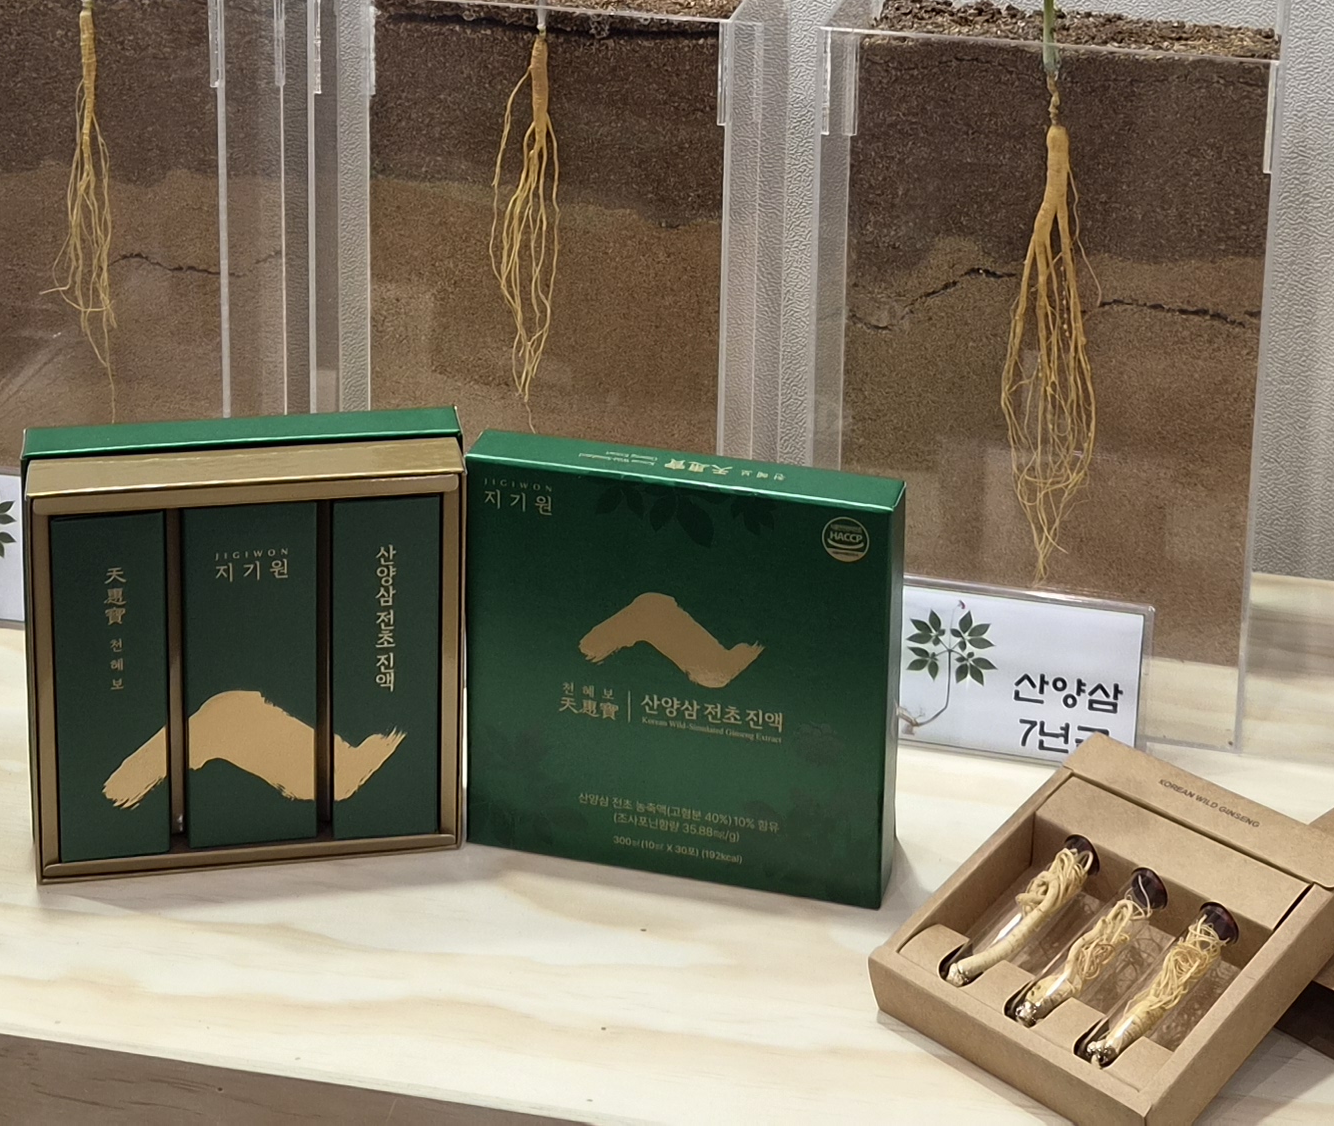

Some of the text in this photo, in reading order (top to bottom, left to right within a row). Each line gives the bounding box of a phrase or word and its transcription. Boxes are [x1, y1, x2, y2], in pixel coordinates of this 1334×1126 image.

[484, 477, 552, 492] JIGIWON
[484, 488, 553, 516] 지기원
[829, 531, 863, 543] HACCP
[215, 548, 289, 561] JIGIWON
[215, 558, 289, 583] 지기원
[375, 544, 397, 692] 산양삼 전초 진액
[110, 637, 124, 691] 천혜보
[562, 681, 615, 701] 천혜보
[1013, 672, 1124, 715] 산양삼
[640, 694, 783, 733] 산양삼 전초 진액
[641, 717, 668, 727] Korean
[725, 728, 754, 742] Ginseng
[755, 733, 782, 744] Extract
[1158, 778, 1261, 828] KOREAN WILD GINSENG
